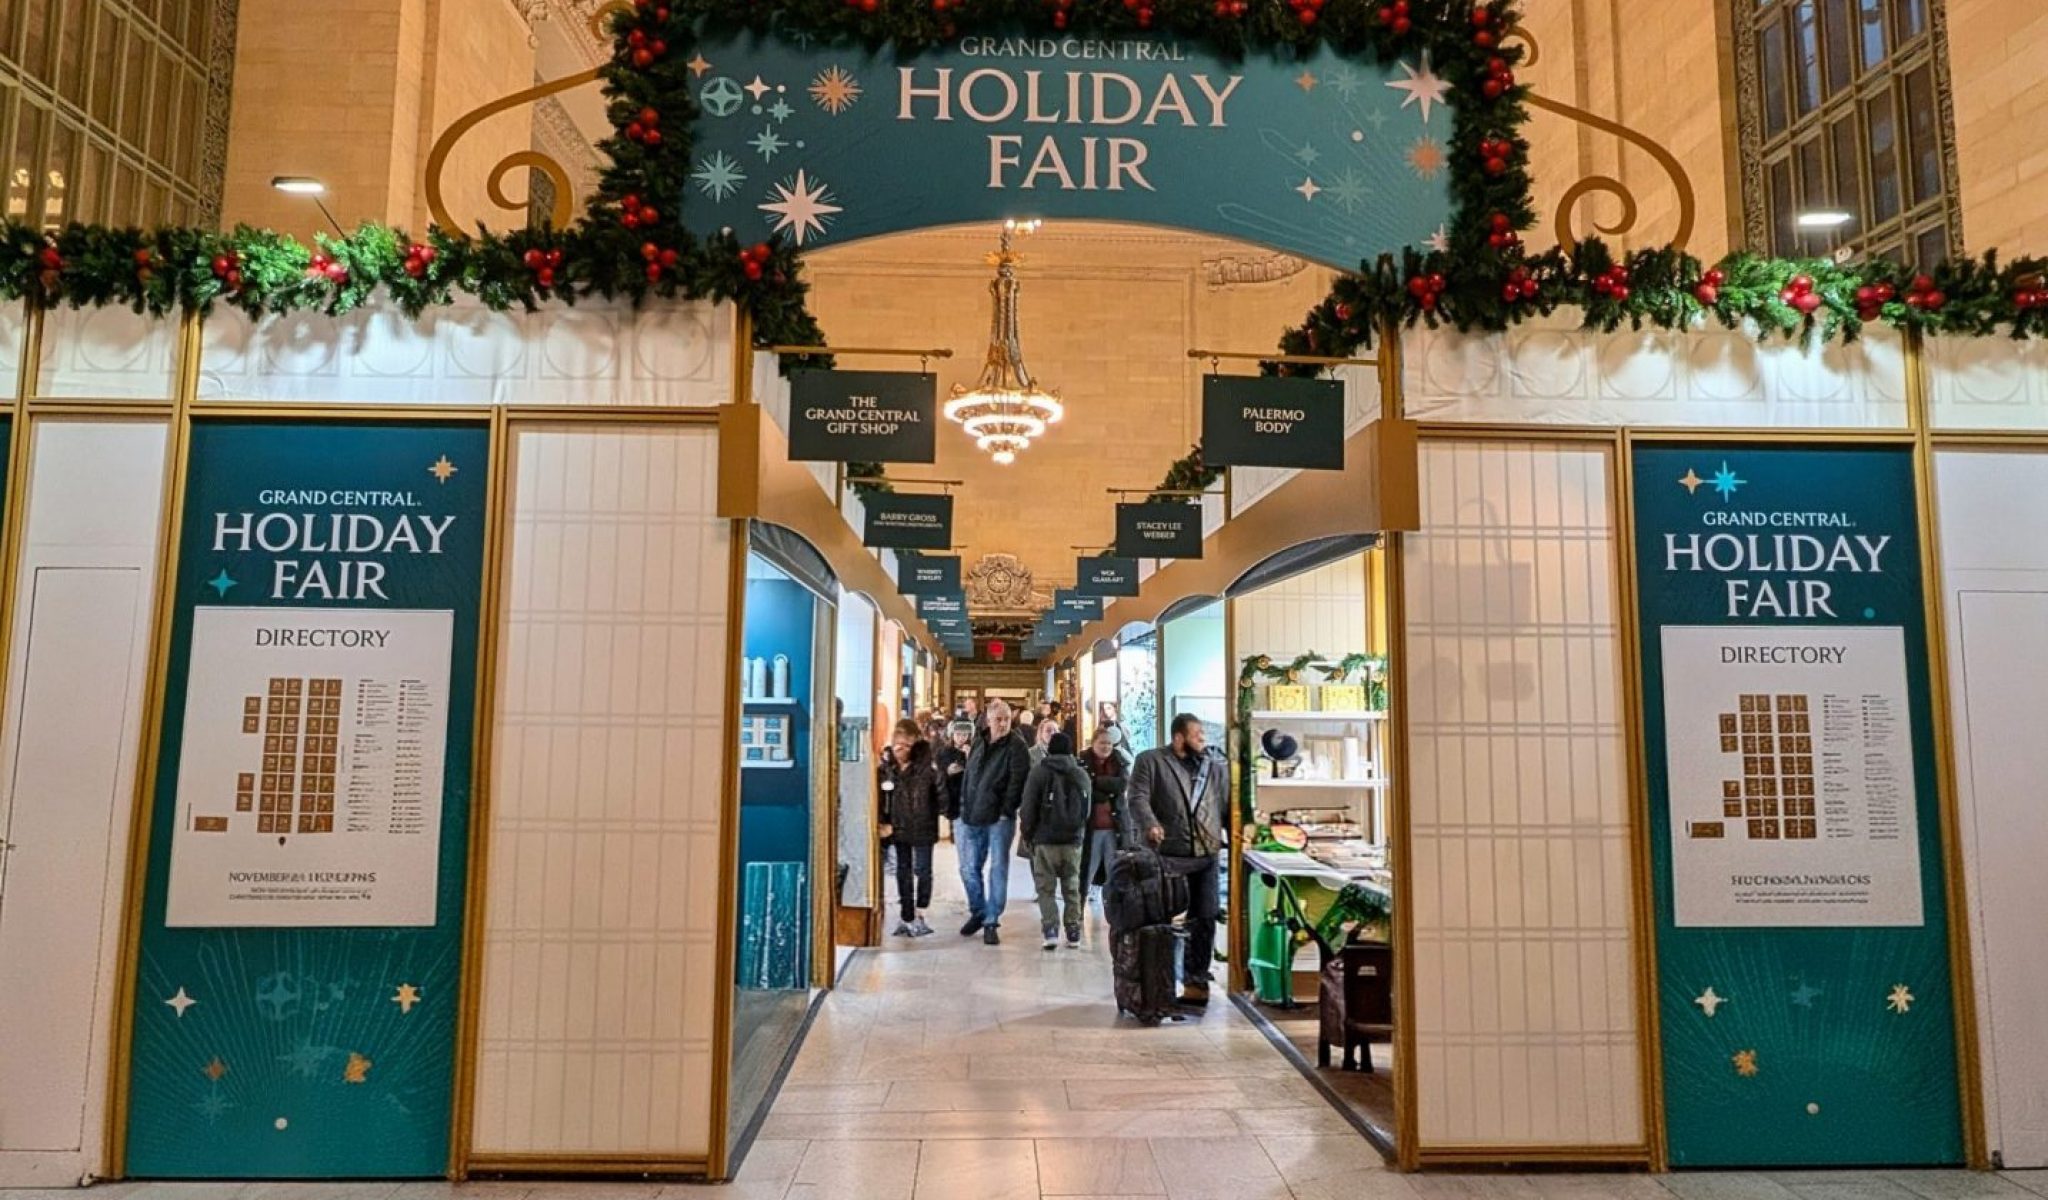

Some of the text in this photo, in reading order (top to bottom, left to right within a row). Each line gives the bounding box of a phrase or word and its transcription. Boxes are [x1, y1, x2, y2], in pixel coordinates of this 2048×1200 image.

[960, 36, 1185, 61] GRAND CENTRAL
[897, 67, 1244, 127] HOLIDAY
[987, 134, 1156, 192] FAIR
[849, 396, 877, 408] THE
[806, 407, 920, 423] GRAND CENTRAL
[1243, 407, 1305, 421] PALERMO
[827, 422, 899, 435] GIFT SHOP
[1255, 421, 1292, 433] BODY
[259, 489, 416, 507] GRAND CENTRAL
[1703, 511, 1851, 527] GRAND CENTRAL
[212, 512, 456, 553] HOLIDAY
[1664, 533, 1891, 572] HOLIDAY
[270, 559, 389, 600] FAIR
[1726, 579, 1838, 618] FAIR
[255, 628, 390, 648] DIRECTORY
[1721, 646, 1846, 664] DIRECTORY
